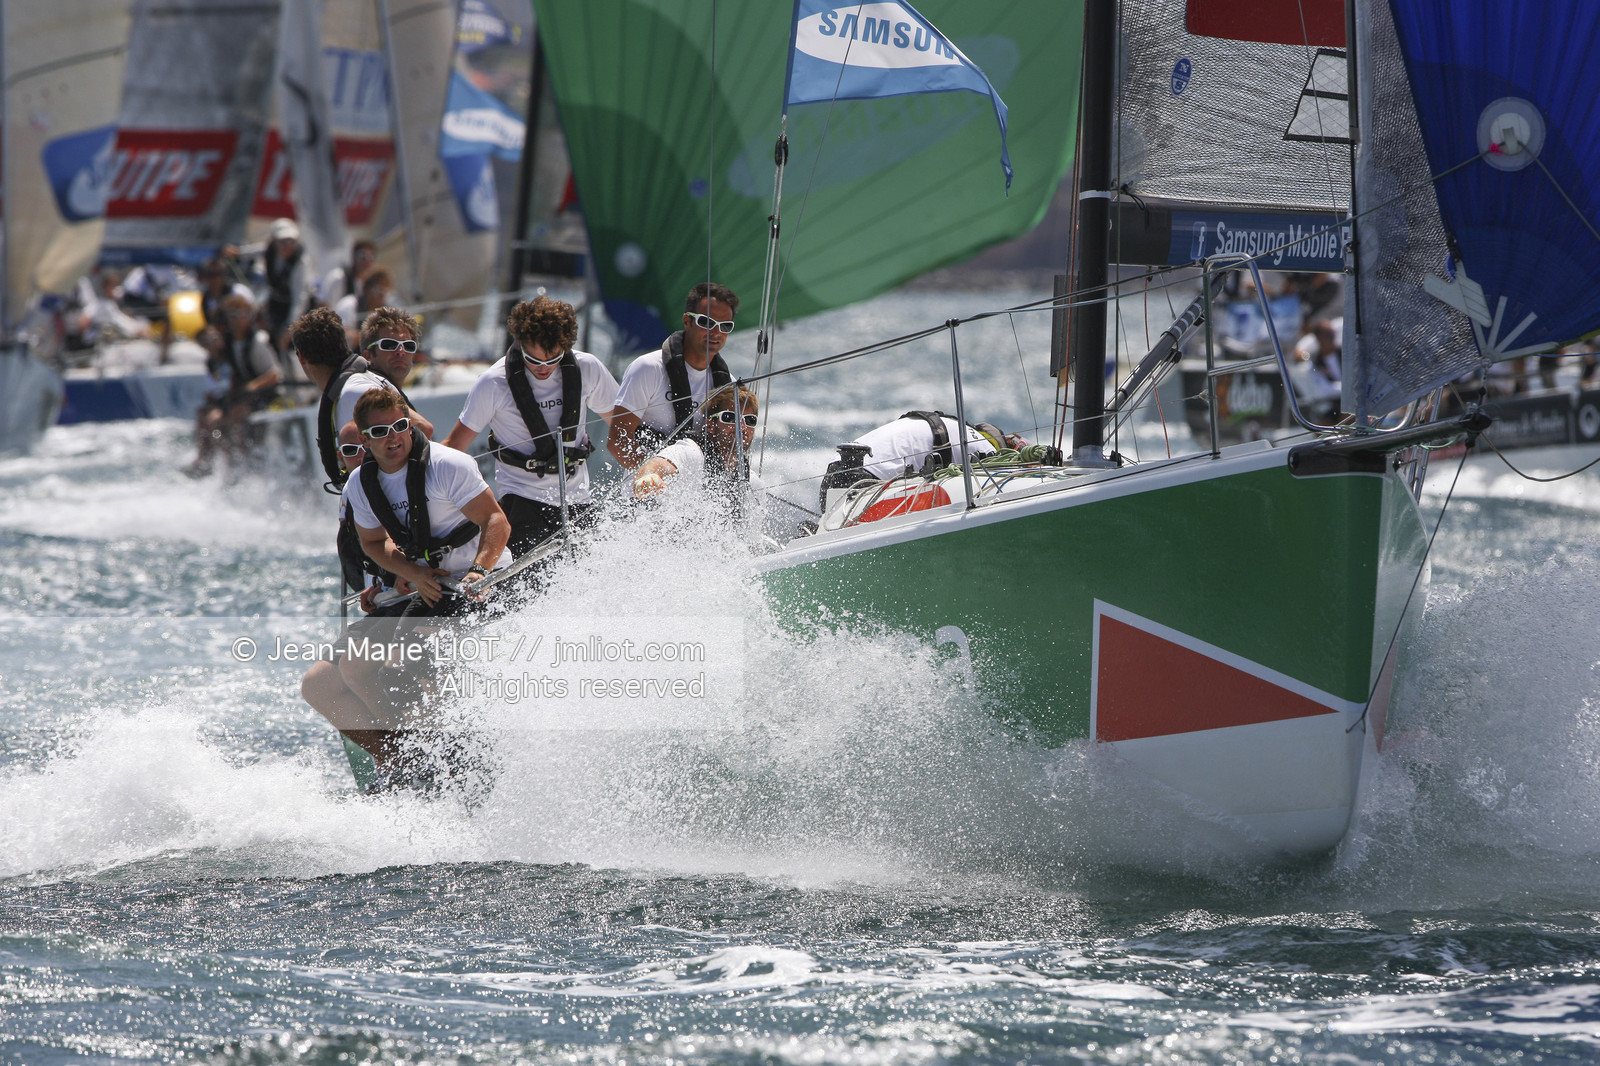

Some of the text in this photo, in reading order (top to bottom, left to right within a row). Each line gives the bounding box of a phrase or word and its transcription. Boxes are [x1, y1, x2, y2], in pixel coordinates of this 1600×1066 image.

[818, 9, 956, 60] SAMSUN
[1215, 221, 1284, 266] Samsung
[1287, 224, 1337, 259] Mobile
